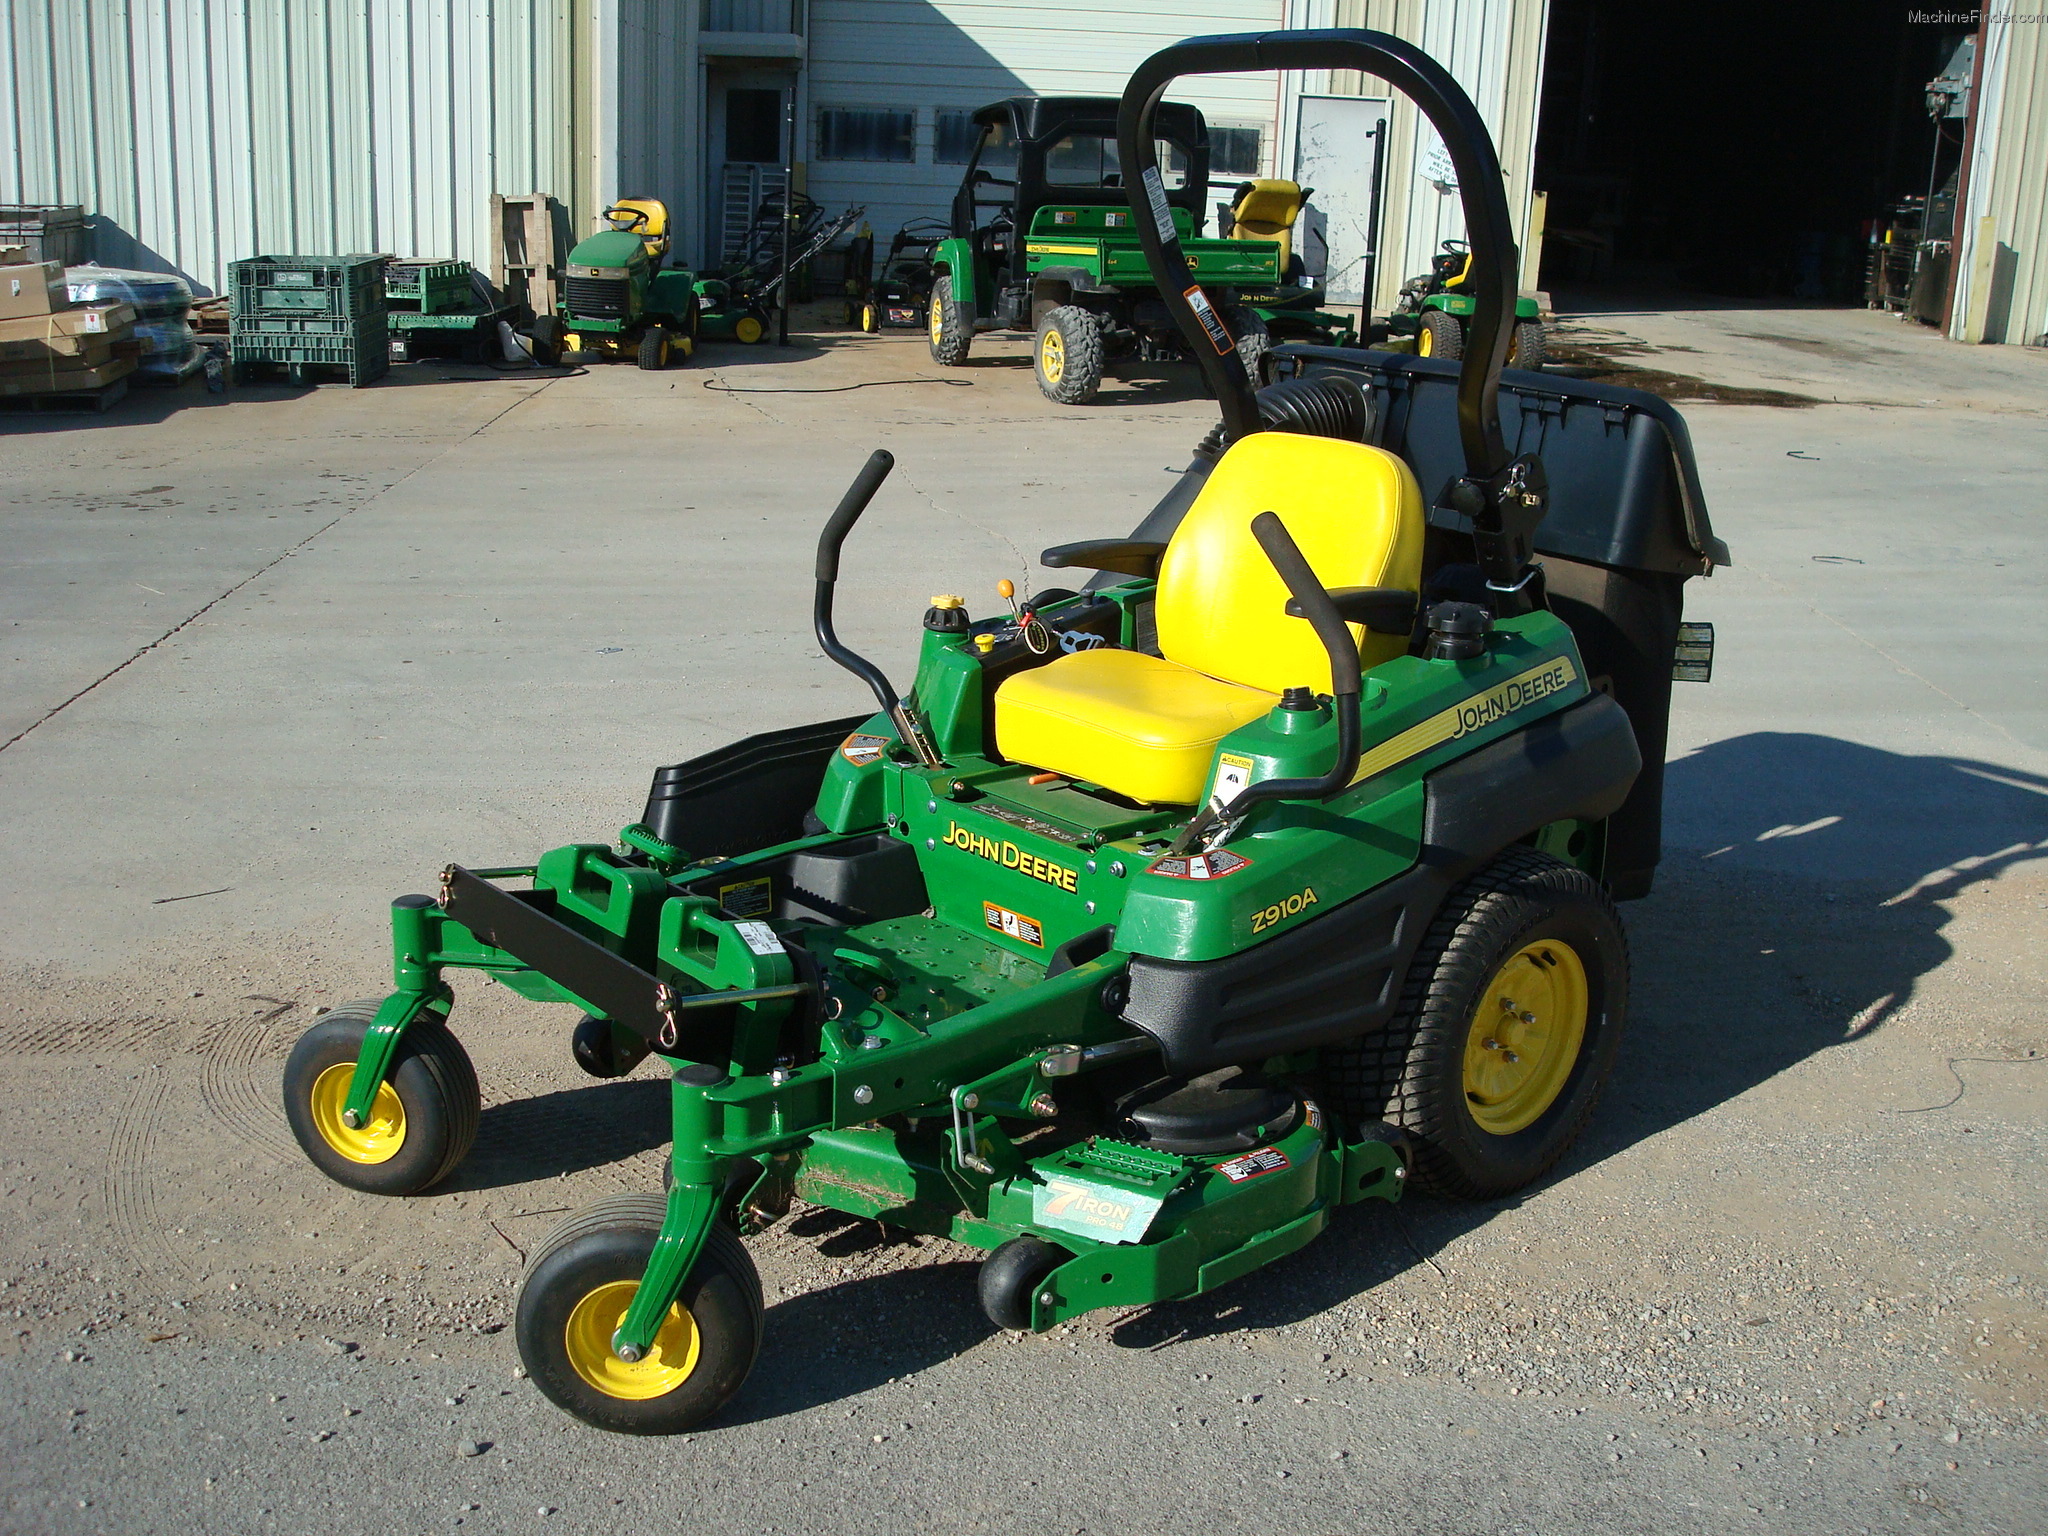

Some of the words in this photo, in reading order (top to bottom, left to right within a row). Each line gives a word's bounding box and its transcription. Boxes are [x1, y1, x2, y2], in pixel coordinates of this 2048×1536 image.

[1453, 693, 1507, 739] JOHN
[1506, 665, 1567, 712] DEERE
[942, 820, 1000, 864] JOHN
[1001, 840, 1078, 895] DEERE
[1250, 886, 1319, 935] Z910A
[1045, 1181, 1089, 1216] 7
[1074, 1194, 1131, 1222] IRON
[1086, 1215, 1107, 1226] PRO
